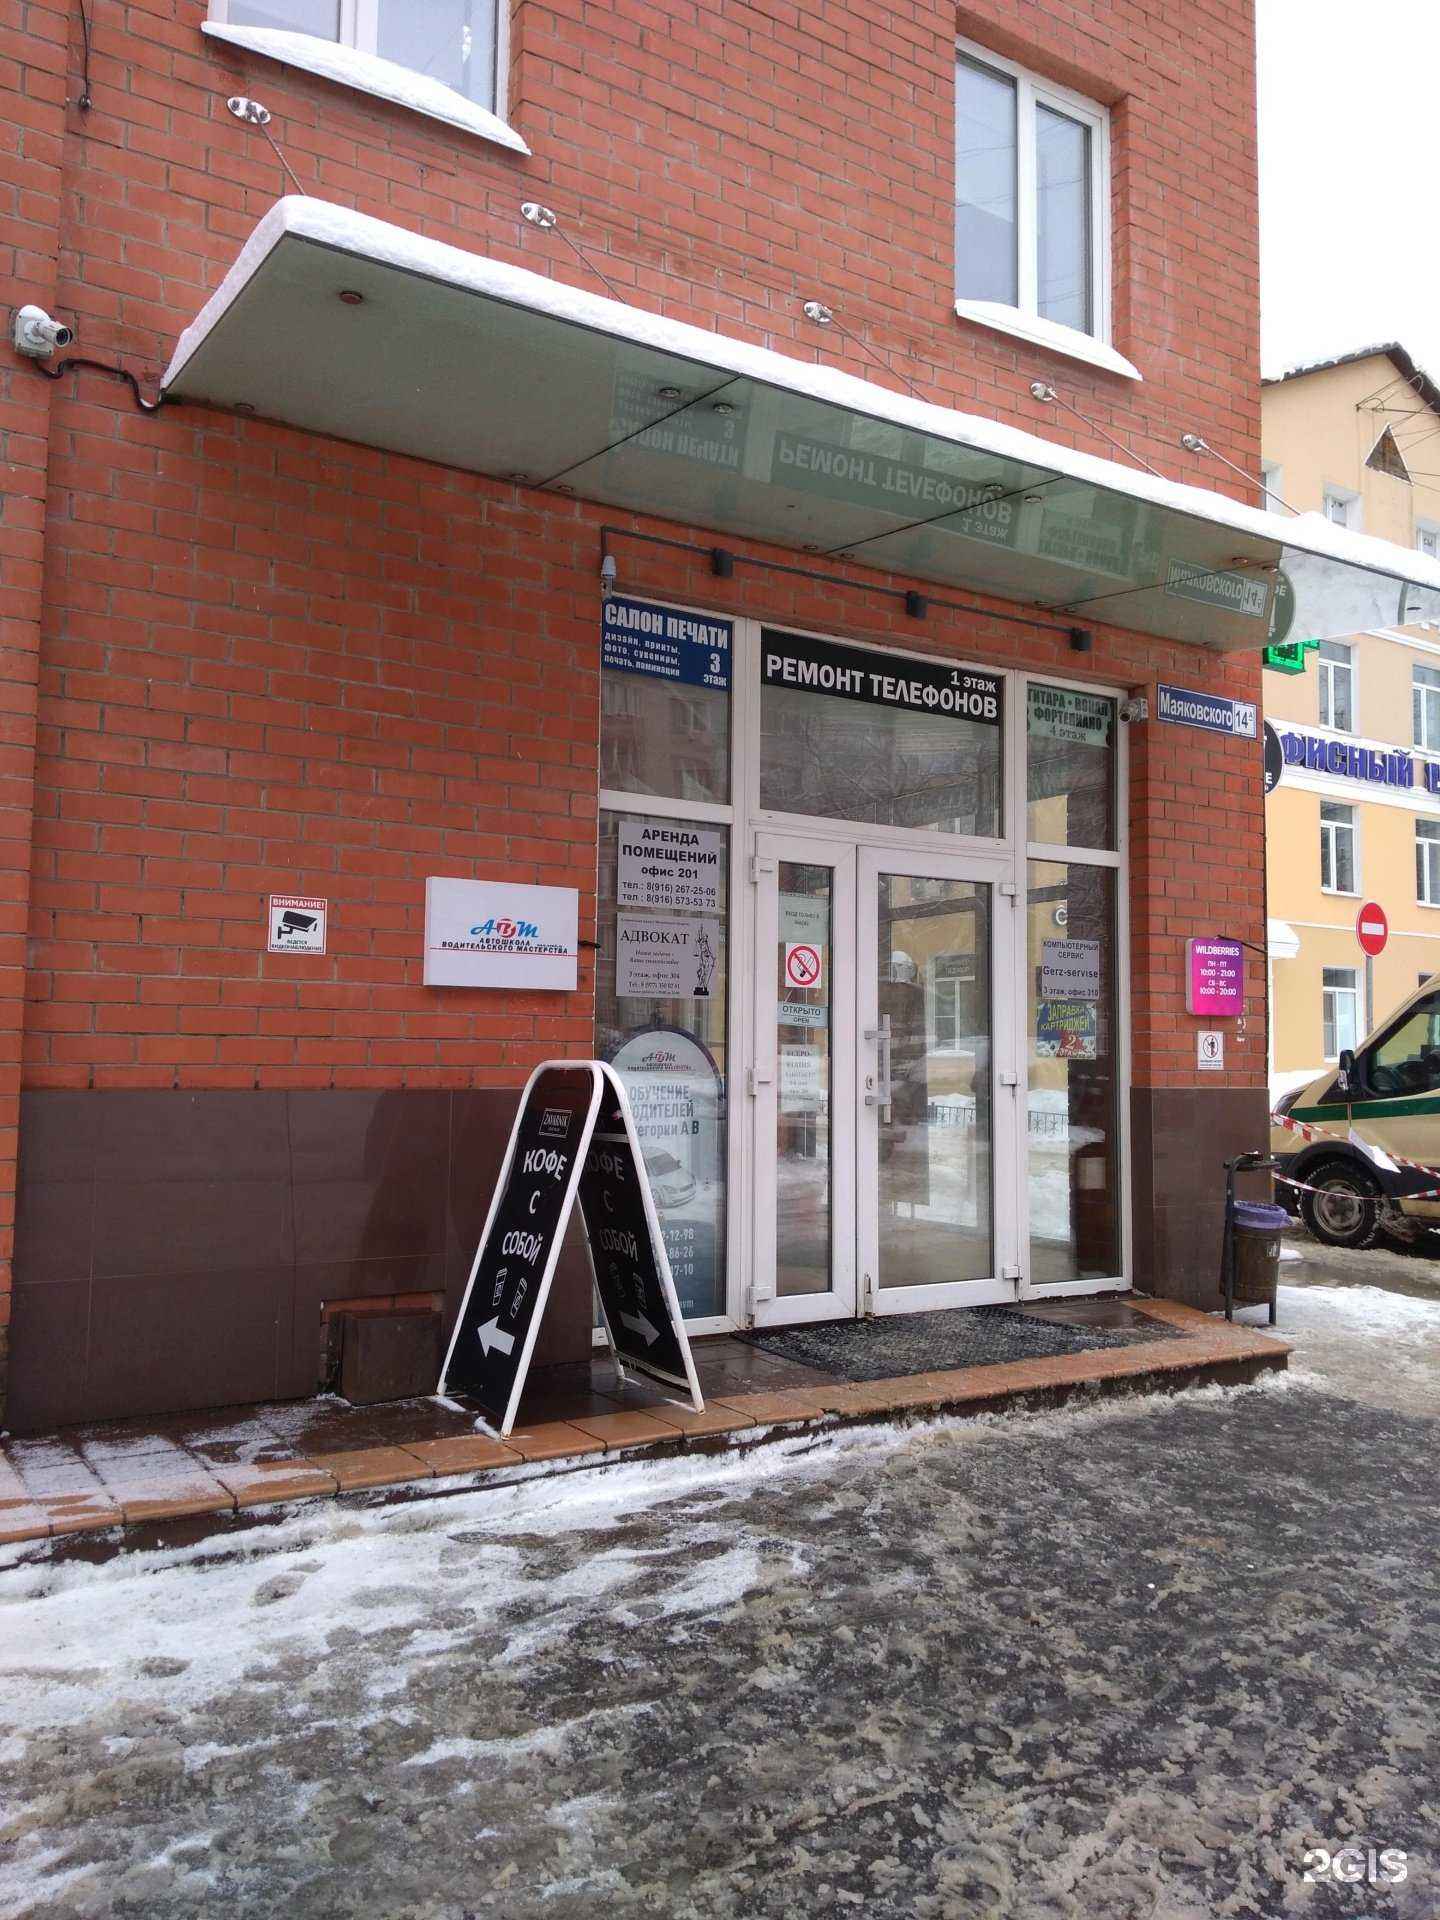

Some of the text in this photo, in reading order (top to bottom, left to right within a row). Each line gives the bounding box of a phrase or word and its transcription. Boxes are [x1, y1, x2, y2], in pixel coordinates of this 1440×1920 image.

[605, 603, 728, 650] САЛОН ПЕЧАТИ
[710, 653, 721, 674] 3
[703, 673, 727, 687] этаж
[766, 653, 997, 719] РЕМОНТ ТЕЛЕФОНОВ
[950, 671, 997, 693] 1 этаж
[1027, 687, 1066, 709] ГИТАРА
[1160, 691, 1233, 726] Маяковского
[1281, 731, 1414, 789] ФИСНЫЙ
[641, 828, 700, 846] АРЕНДА
[622, 844, 717, 865] ПОМЕЩЕНИЙ
[641, 865, 698, 879] офис 201
[646, 882, 673, 893] 8(916)
[272, 898, 324, 909] ВНИМАНИЕ!
[646, 893, 673, 905] 8(916)
[479, 937, 531, 946] АВТОШКОЛА
[620, 929, 690, 945] АДВОКАТ
[441, 941, 513, 952] ВОДИТЕЛЬСКОГО
[516, 945, 568, 954] МАСТЕРСТВА
[1195, 945, 1240, 956] WILDBERRIES
[1043, 965, 1099, 978] Gerz-servise
[1200, 968, 1216, 976] 10:00
[782, 1005, 821, 1016] ОТКРЫТО
[1065, 1034, 1077, 1050] 2
[630, 1084, 690, 1100] ОБУЧЕНИЕ
[633, 1099, 694, 1121] ОДИТЕЛЕЙ
[636, 1124, 678, 1139] егории
[523, 1148, 568, 1181] КОФЕ
[529, 1190, 541, 1214] С
[502, 1230, 544, 1267] СОБОЙ
[599, 1227, 639, 1263] СОБОЙ
